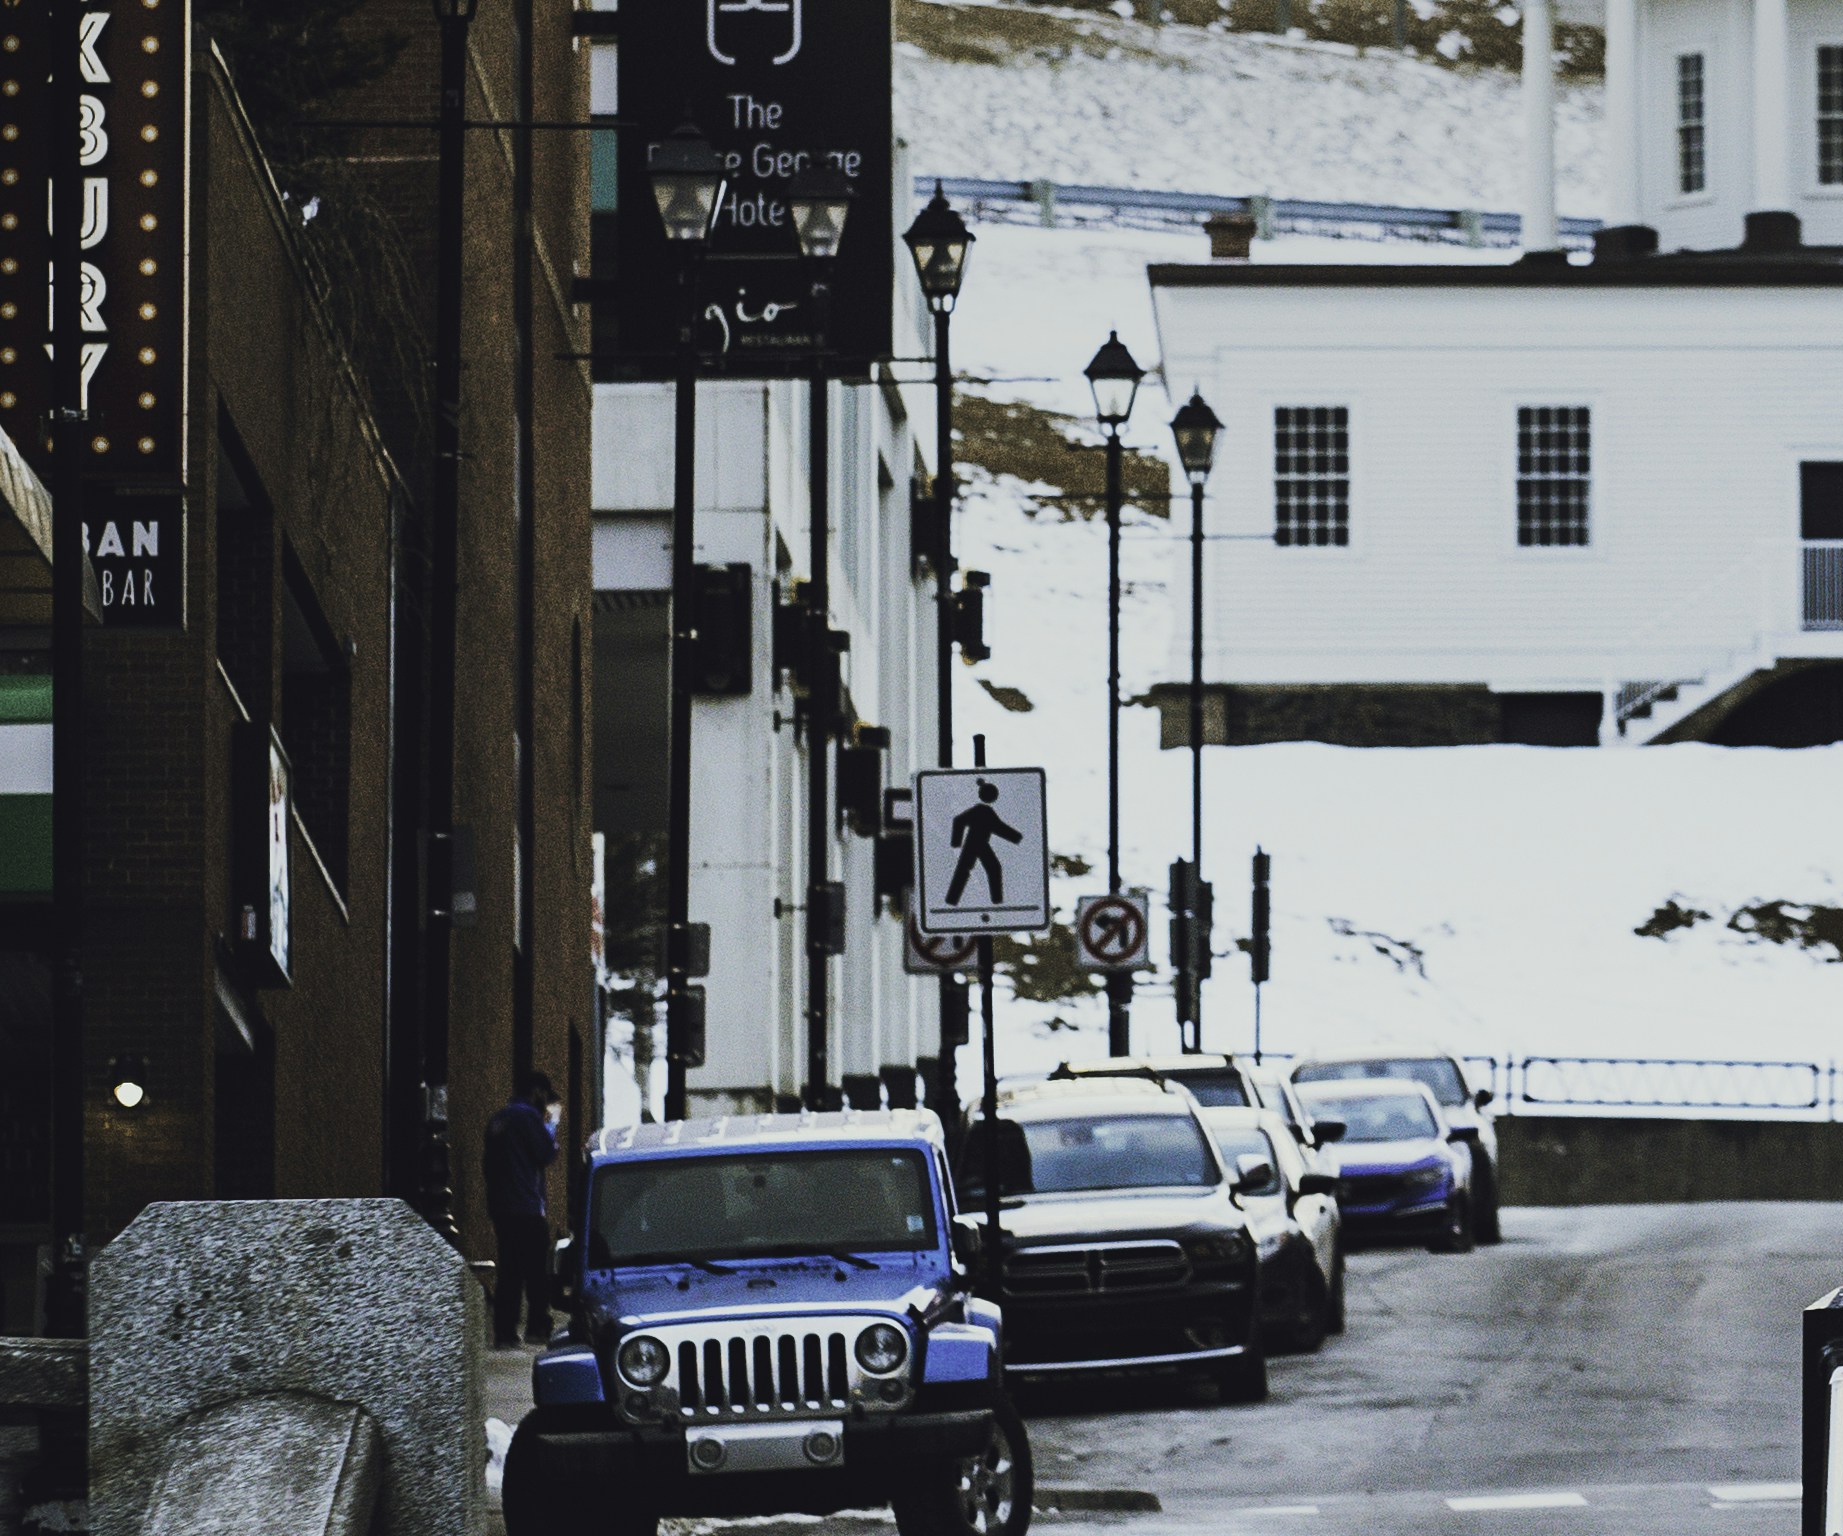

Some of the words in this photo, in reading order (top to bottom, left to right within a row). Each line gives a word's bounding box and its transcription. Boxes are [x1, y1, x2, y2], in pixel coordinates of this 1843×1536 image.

[726, 93, 784, 130] The
[722, 192, 786, 227] Hote
[703, 286, 800, 355] gio
[101, 567, 157, 608] BAR
